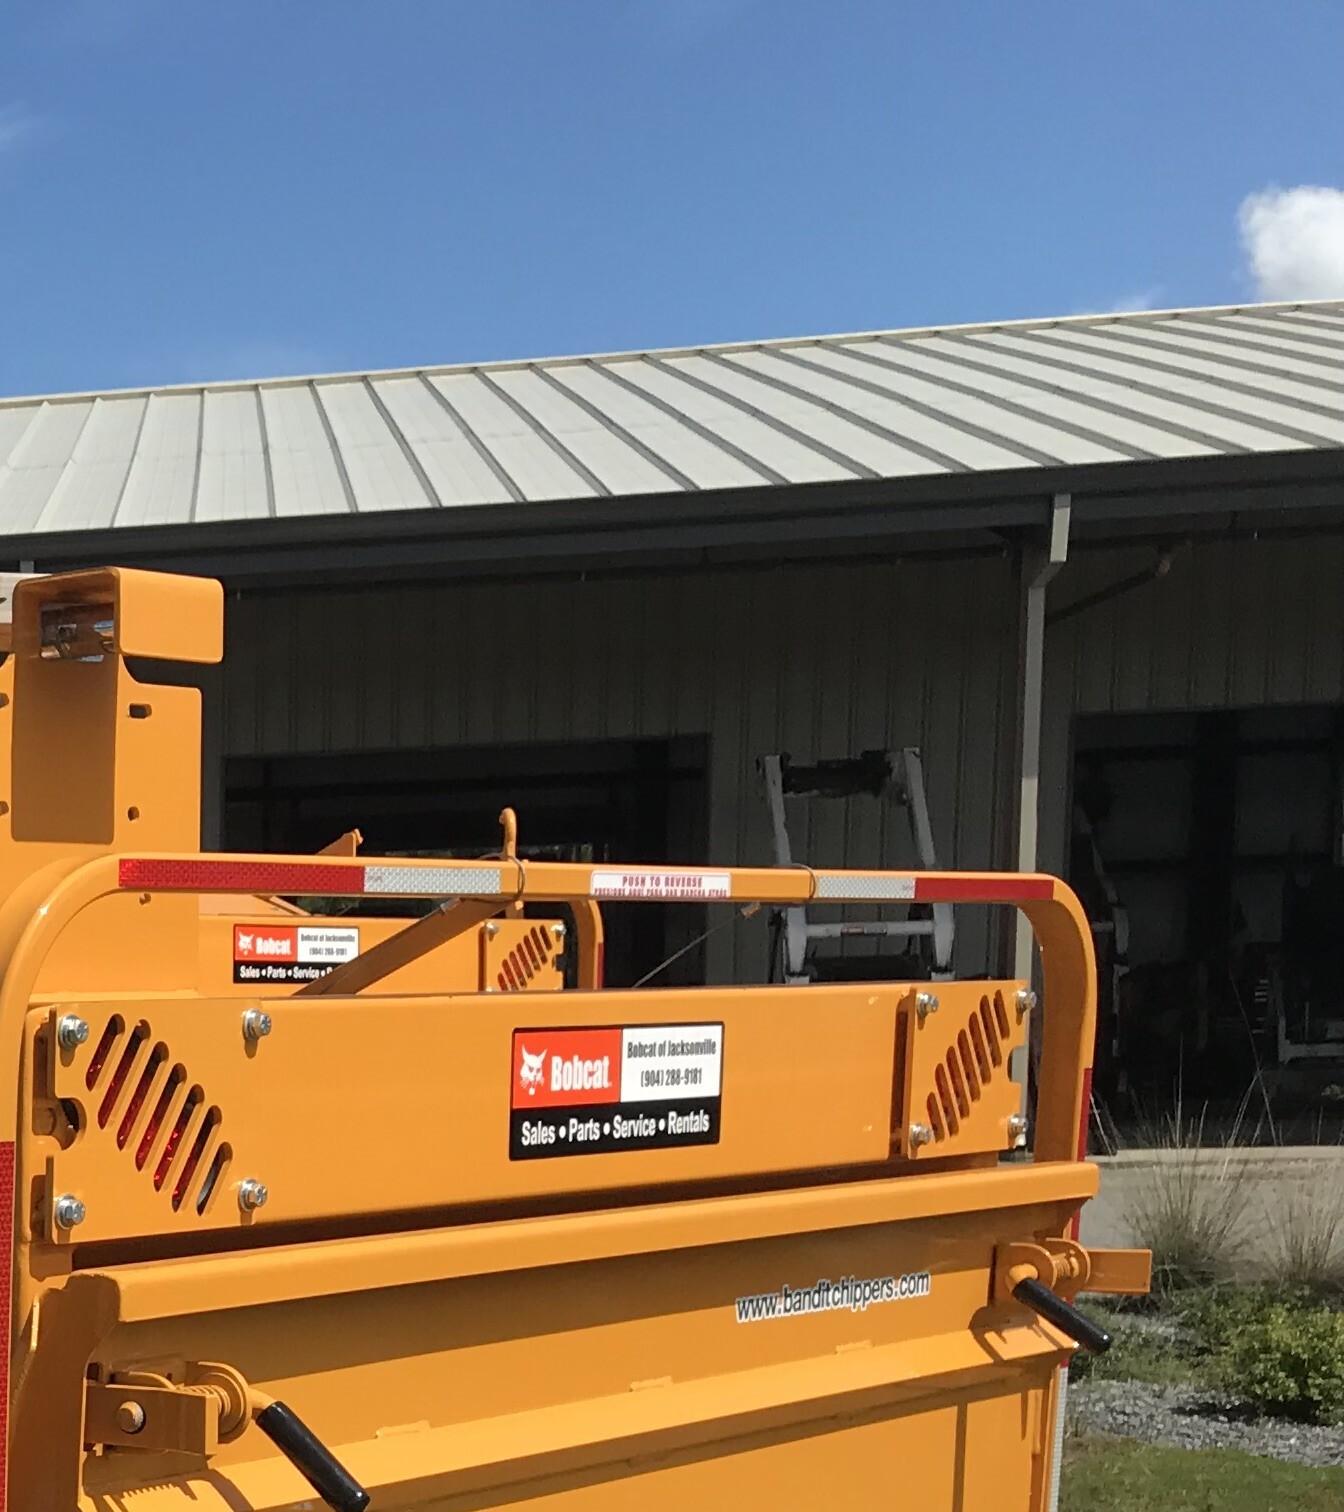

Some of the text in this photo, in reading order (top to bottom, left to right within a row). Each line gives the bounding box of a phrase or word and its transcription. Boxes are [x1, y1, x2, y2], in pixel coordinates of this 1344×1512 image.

[622, 876, 703, 888] PUSH TO REVERSE
[256, 937, 291, 955] Bobcat
[240, 965, 260, 978] Sales
[266, 966, 286, 979] Parts
[293, 967, 319, 979] Service
[627, 1039, 716, 1059] Bobcat of Jacksonville
[551, 1055, 610, 1091] Bobcat
[641, 1068, 702, 1087] (904) 288-9181
[521, 1109, 710, 1146] Sales Parts Service Rentals
[737, 1272, 929, 1320] www.banditchippers.com
